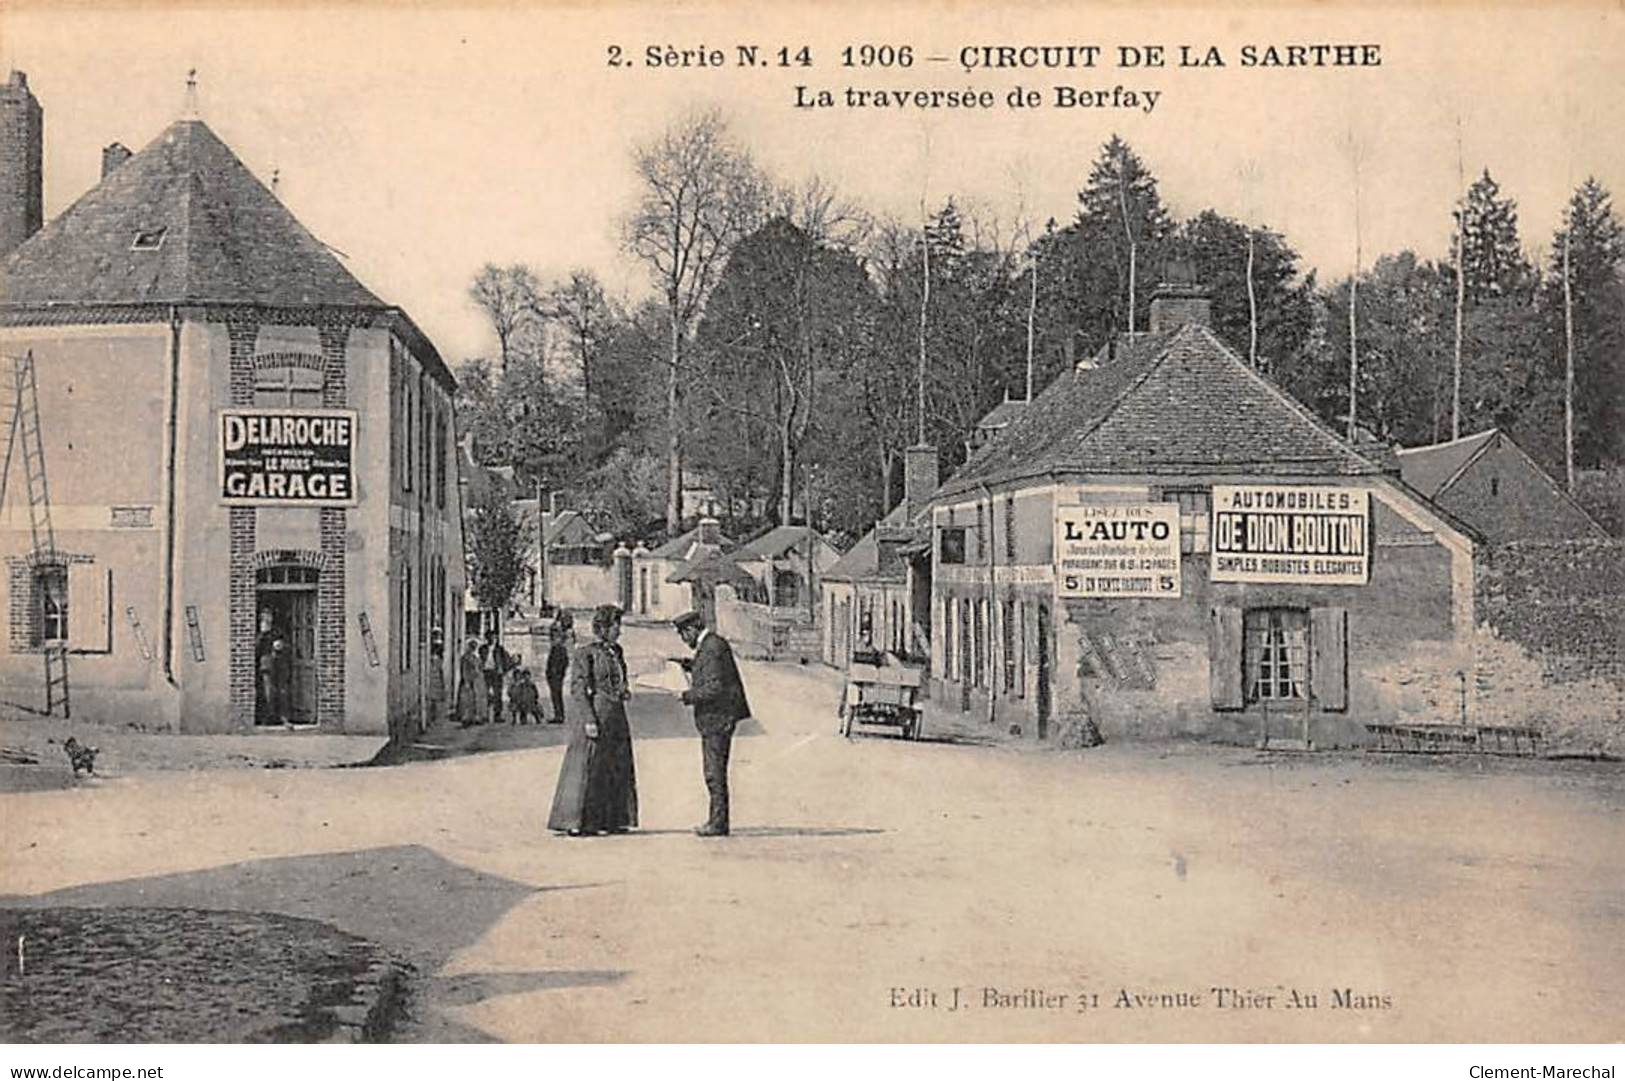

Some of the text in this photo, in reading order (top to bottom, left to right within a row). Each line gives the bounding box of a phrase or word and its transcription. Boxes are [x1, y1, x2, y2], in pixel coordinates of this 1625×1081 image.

[225, 416, 349, 451] DELAROCHE
[226, 472, 348, 498] GARAGE
[1232, 491, 1350, 510] AUTOMOBILES
[1064, 520, 1170, 541] L'AUTO
[1218, 513, 1243, 552] DE
[1065, 576, 1079, 591] 5
[1160, 576, 1175, 591] 5
